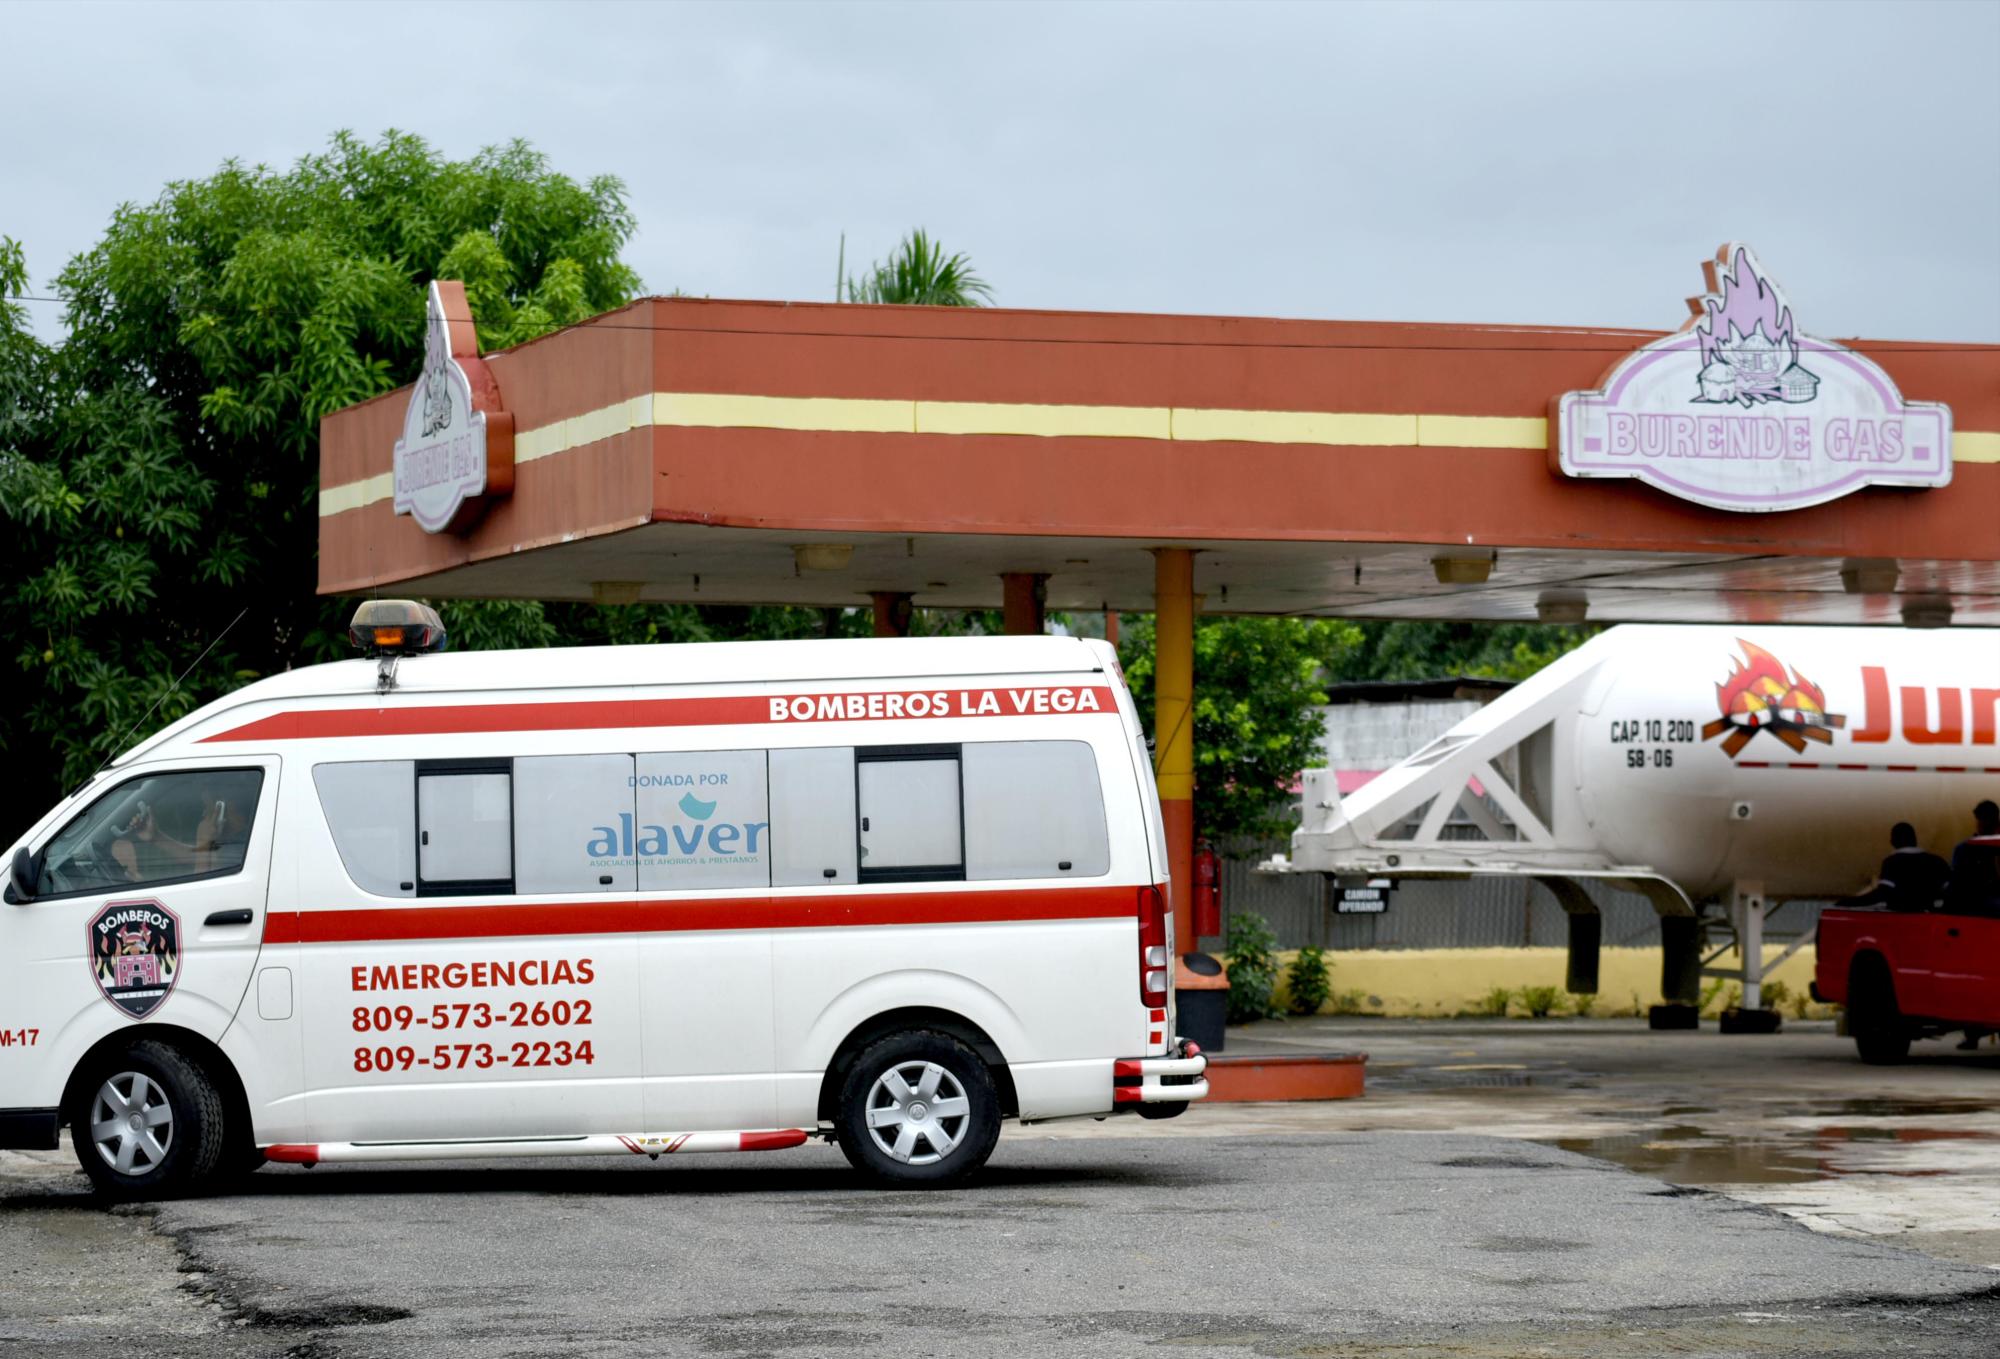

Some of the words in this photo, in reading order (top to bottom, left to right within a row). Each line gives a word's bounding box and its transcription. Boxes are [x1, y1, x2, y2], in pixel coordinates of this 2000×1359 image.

[1606, 411, 1811, 461] BURENDE
[1824, 417, 1905, 463] GAS
[769, 692, 950, 721] BOMBEROS
[960, 691, 1001, 715] LA
[1008, 688, 1100, 713] VEGA
[628, 774, 694, 787] DONADA
[700, 774, 728, 785] POR
[587, 812, 768, 858] alaver
[657, 857, 697, 865] AHORROS
[98, 910, 169, 934] BOMBEROS
[1338, 901, 1384, 913] OPERANDO
[351, 958, 594, 991] EMERGENCIAS
[352, 1000, 592, 1032] 809-573-2602
[353, 1040, 594, 1073] 809-573-2234
